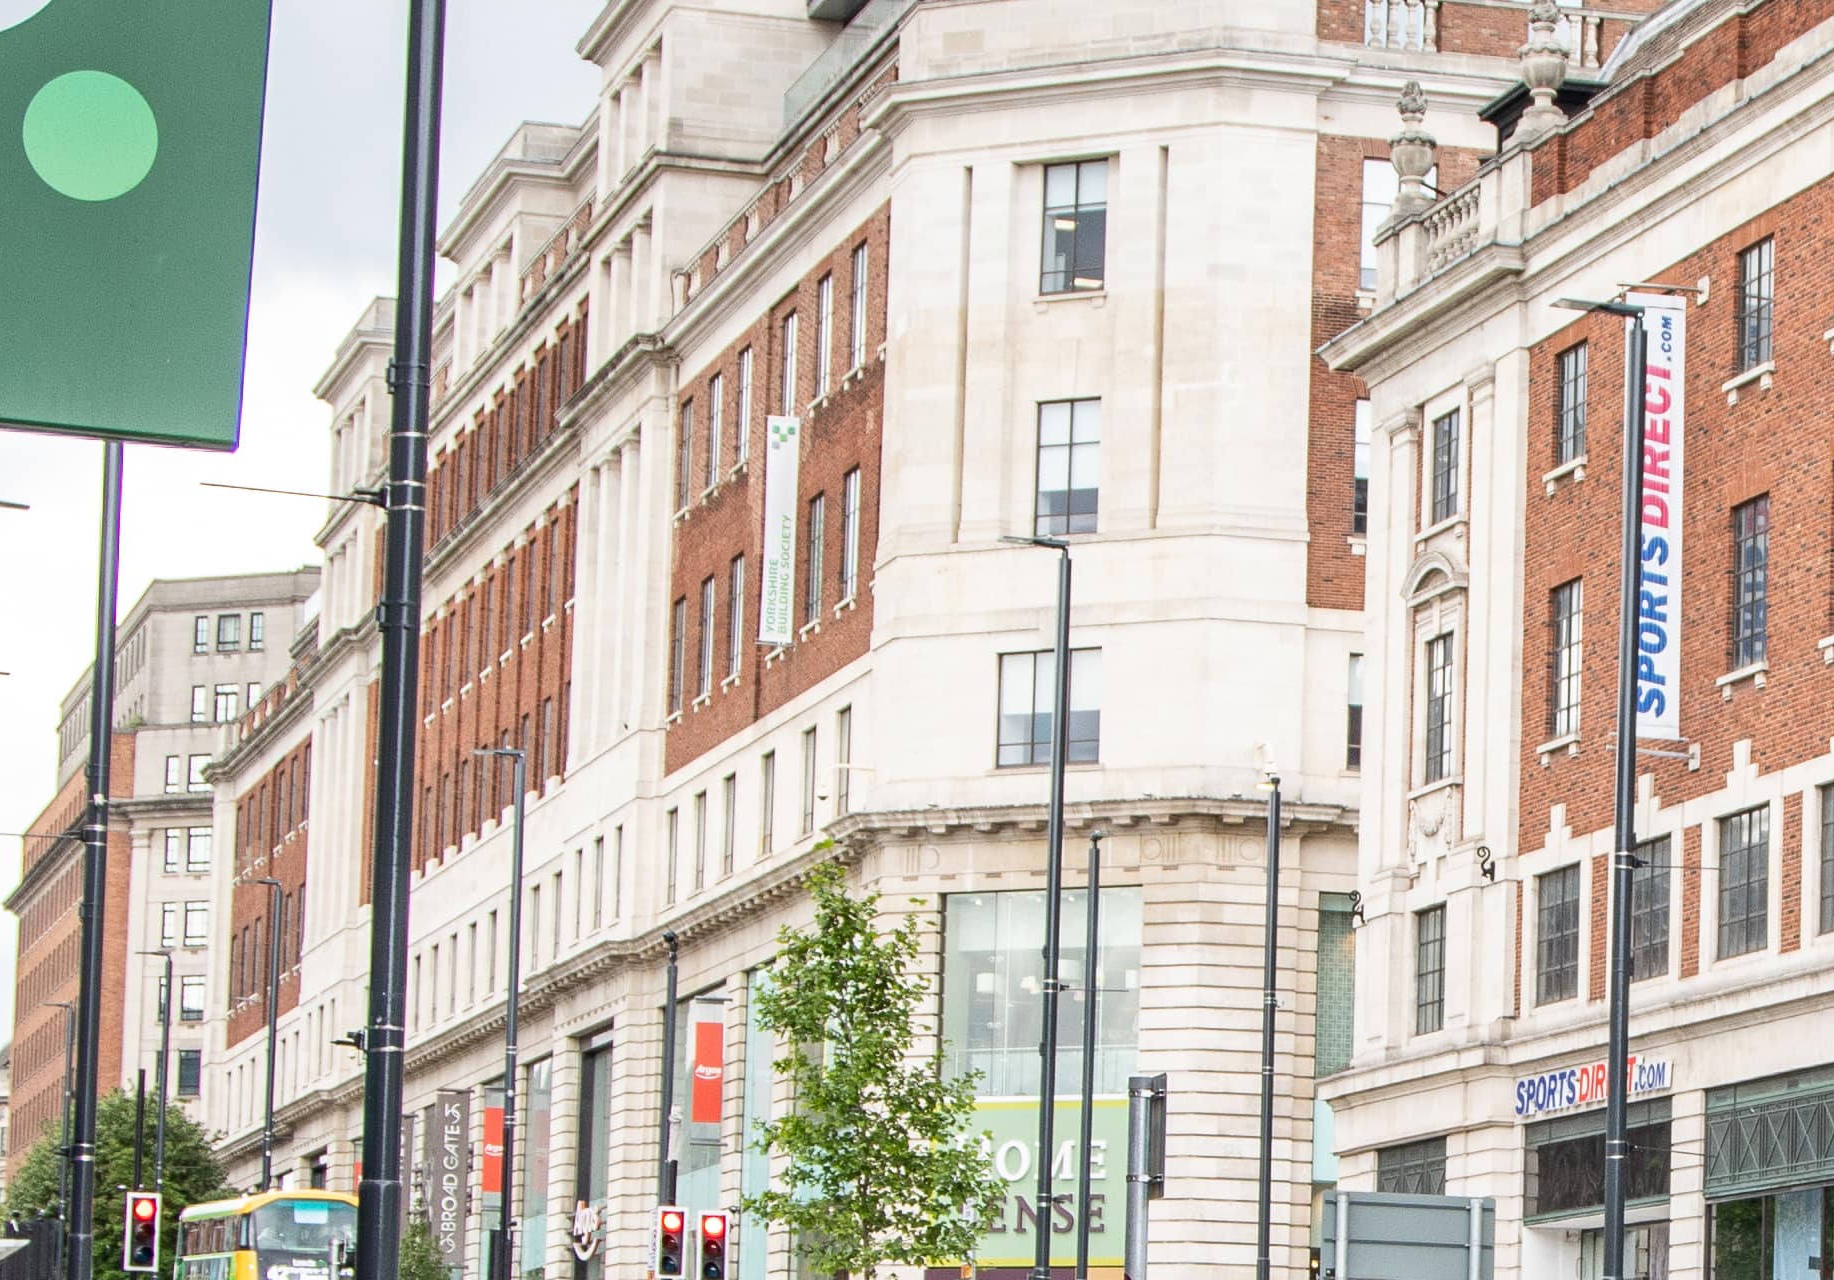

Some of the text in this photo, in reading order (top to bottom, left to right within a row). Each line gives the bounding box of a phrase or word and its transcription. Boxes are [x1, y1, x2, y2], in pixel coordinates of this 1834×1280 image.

[766, 558, 779, 633] YORKSHIRE
[778, 514, 791, 634] BUILDING SOCIETY
[959, 1193, 1106, 1234] ENSE
